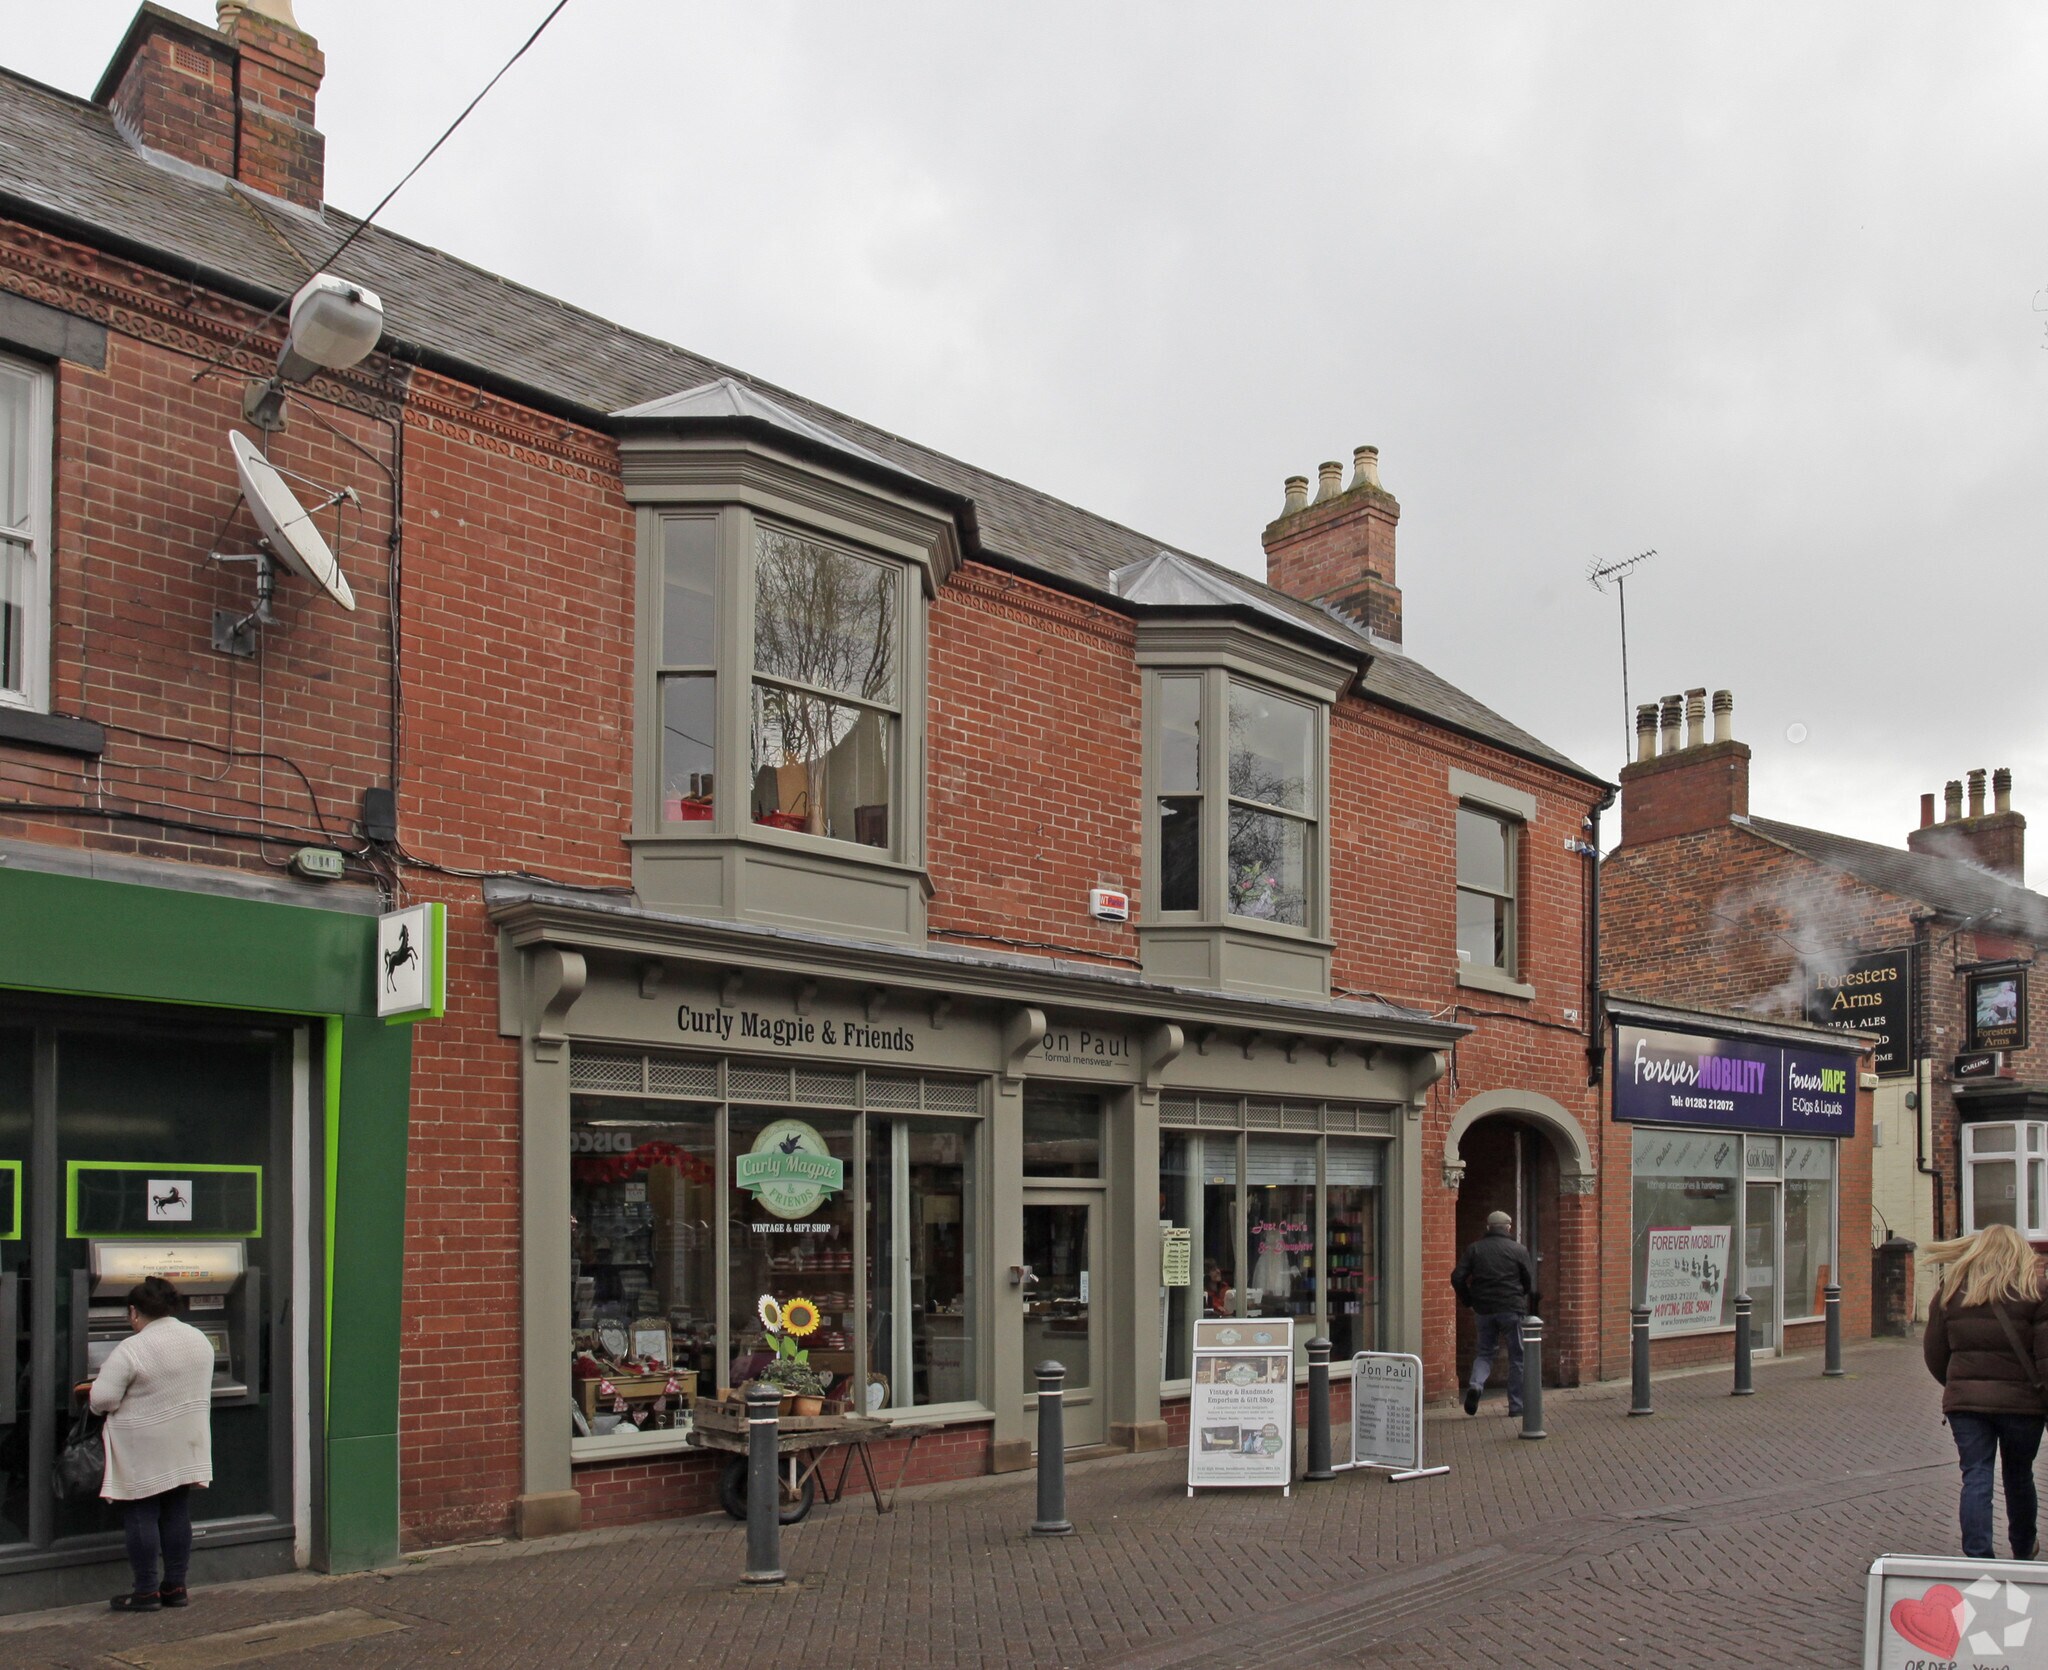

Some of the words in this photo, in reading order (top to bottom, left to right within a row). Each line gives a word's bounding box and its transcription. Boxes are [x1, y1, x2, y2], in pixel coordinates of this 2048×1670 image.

[1816, 967, 1897, 991] Foresters
[1831, 990, 1882, 1011] Arms
[677, 1005, 734, 1041] Curly
[741, 1011, 815, 1047] Magpie
[821, 1020, 837, 1045] &
[843, 1022, 915, 1052] Friends
[1860, 1016, 1886, 1027] ALES
[1977, 1026, 2017, 1038] Foresters
[1042, 1032, 1069, 1052] on
[1080, 1031, 1129, 1057] Paul
[1875, 1036, 1889, 1045] OD
[1984, 1036, 2010, 1047] Arms
[1045, 1051, 1071, 1063] formal
[1073, 1055, 1113, 1067] menswear
[1874, 1053, 1893, 1062] OME
[1960, 1058, 1990, 1074] CARLING
[1697, 1055, 1766, 1095] MOBILITY
[1821, 1068, 1846, 1094] VAPE
[1670, 1095, 1684, 1107] Tel:
[1685, 1096, 1707, 1109] 01283
[1708, 1099, 1734, 1112] 212072
[1792, 1097, 1813, 1116] E-Cigs
[1814, 1101, 1820, 1113] &
[1821, 1101, 1843, 1118] Liquids
[1747, 1148, 1761, 1168] Cook
[1761, 1149, 1775, 1169] Shop
[743, 1158, 781, 1178] Curly
[786, 1155, 837, 1180] Magpie
[787, 1183, 796, 1194] &
[769, 1187, 814, 1208] FRIENDS
[752, 1223, 785, 1233] VINTAGE
[786, 1224, 793, 1233] &
[793, 1223, 811, 1234] GIFT
[812, 1223, 831, 1233] SHOP
[1250, 1220, 1276, 1234] Just
[1652, 1235, 1690, 1251] FOREVER
[1690, 1234, 1726, 1249] MOBILITY
[1650, 1258, 1671, 1268] SALES
[1654, 1302, 1680, 1318] MOVING
[1681, 1302, 1694, 1315] HERE
[1360, 1364, 1381, 1376] Jon
[1386, 1365, 1412, 1378] Paul
[1209, 1388, 1232, 1396] Vintage
[1241, 1387, 1273, 1395] Handmade
[1207, 1396, 1240, 1404] Emporium
[1259, 1396, 1275, 1404] Shop
